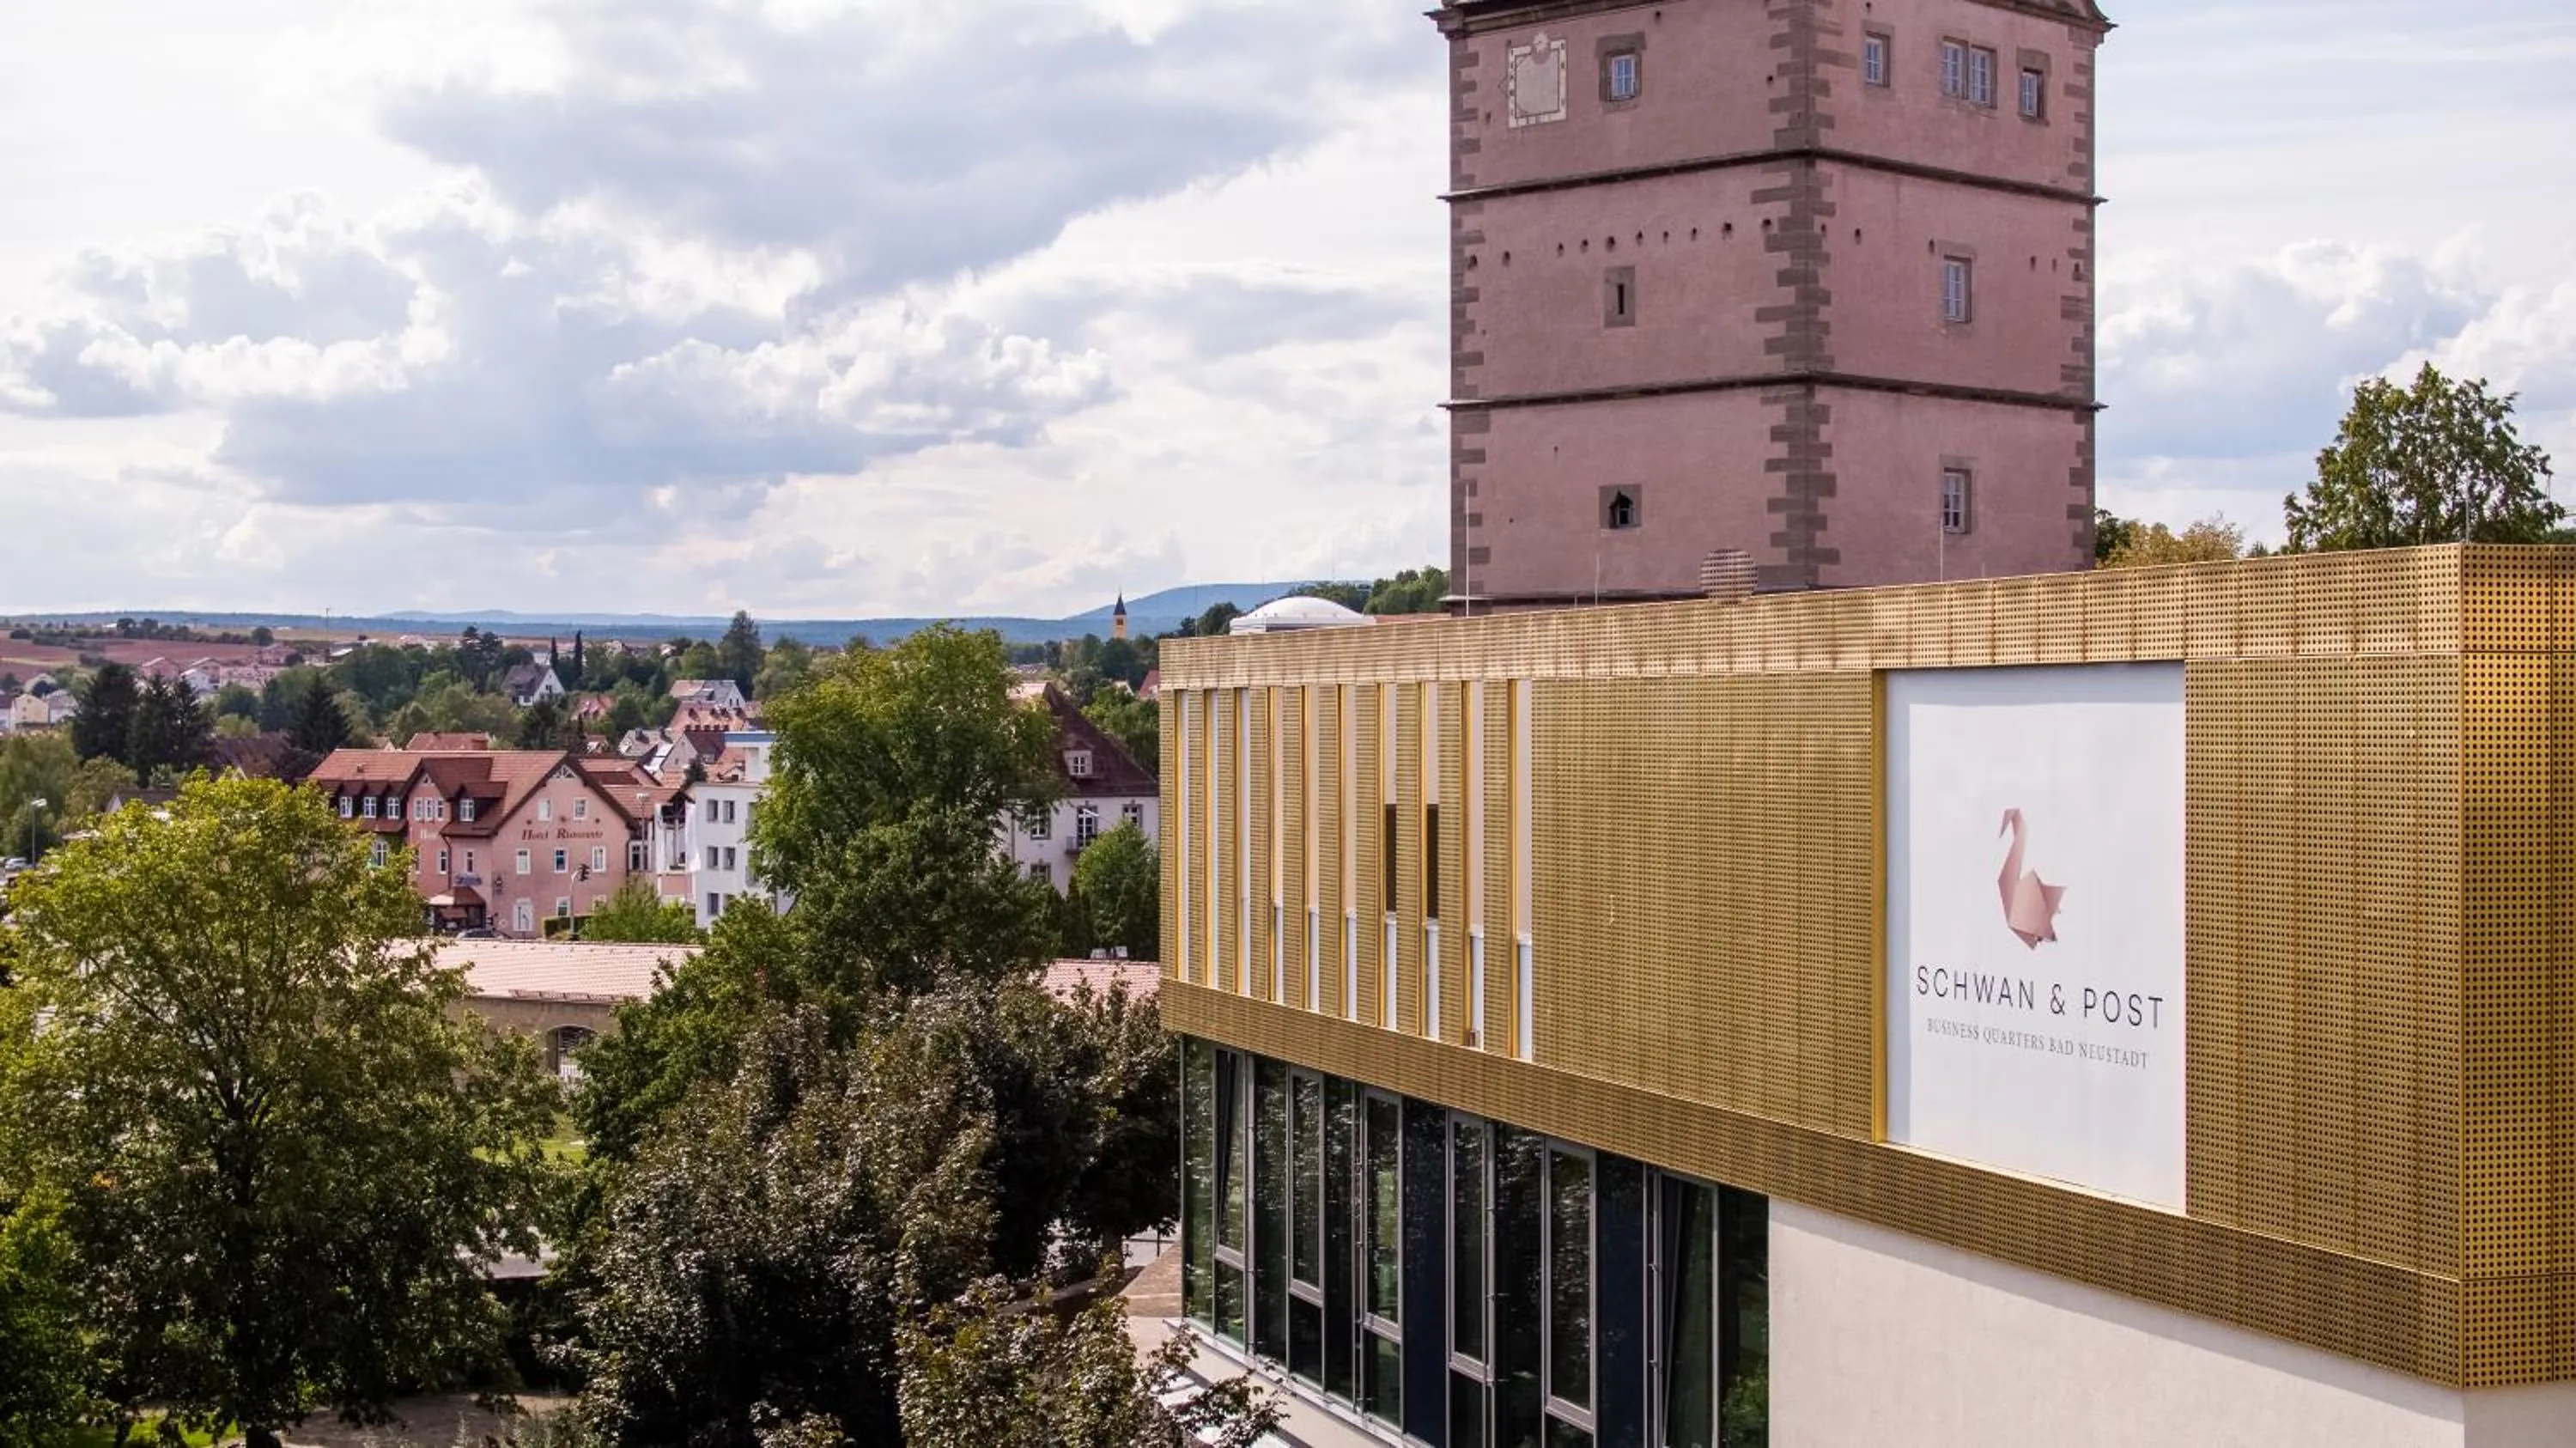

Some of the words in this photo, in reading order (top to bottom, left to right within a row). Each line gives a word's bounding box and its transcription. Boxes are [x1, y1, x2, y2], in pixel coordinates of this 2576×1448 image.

[1917, 965, 2034, 1010] SCHWAN
[2050, 983, 2065, 1015] &
[2083, 987, 2163, 1029] POST
[1927, 1018, 1979, 1040] BUSINESS
[1983, 1028, 2044, 1050] QUARTERS
[2049, 1037, 2075, 1056] BAD
[2078, 1043, 2148, 1069] NEUSTADT
